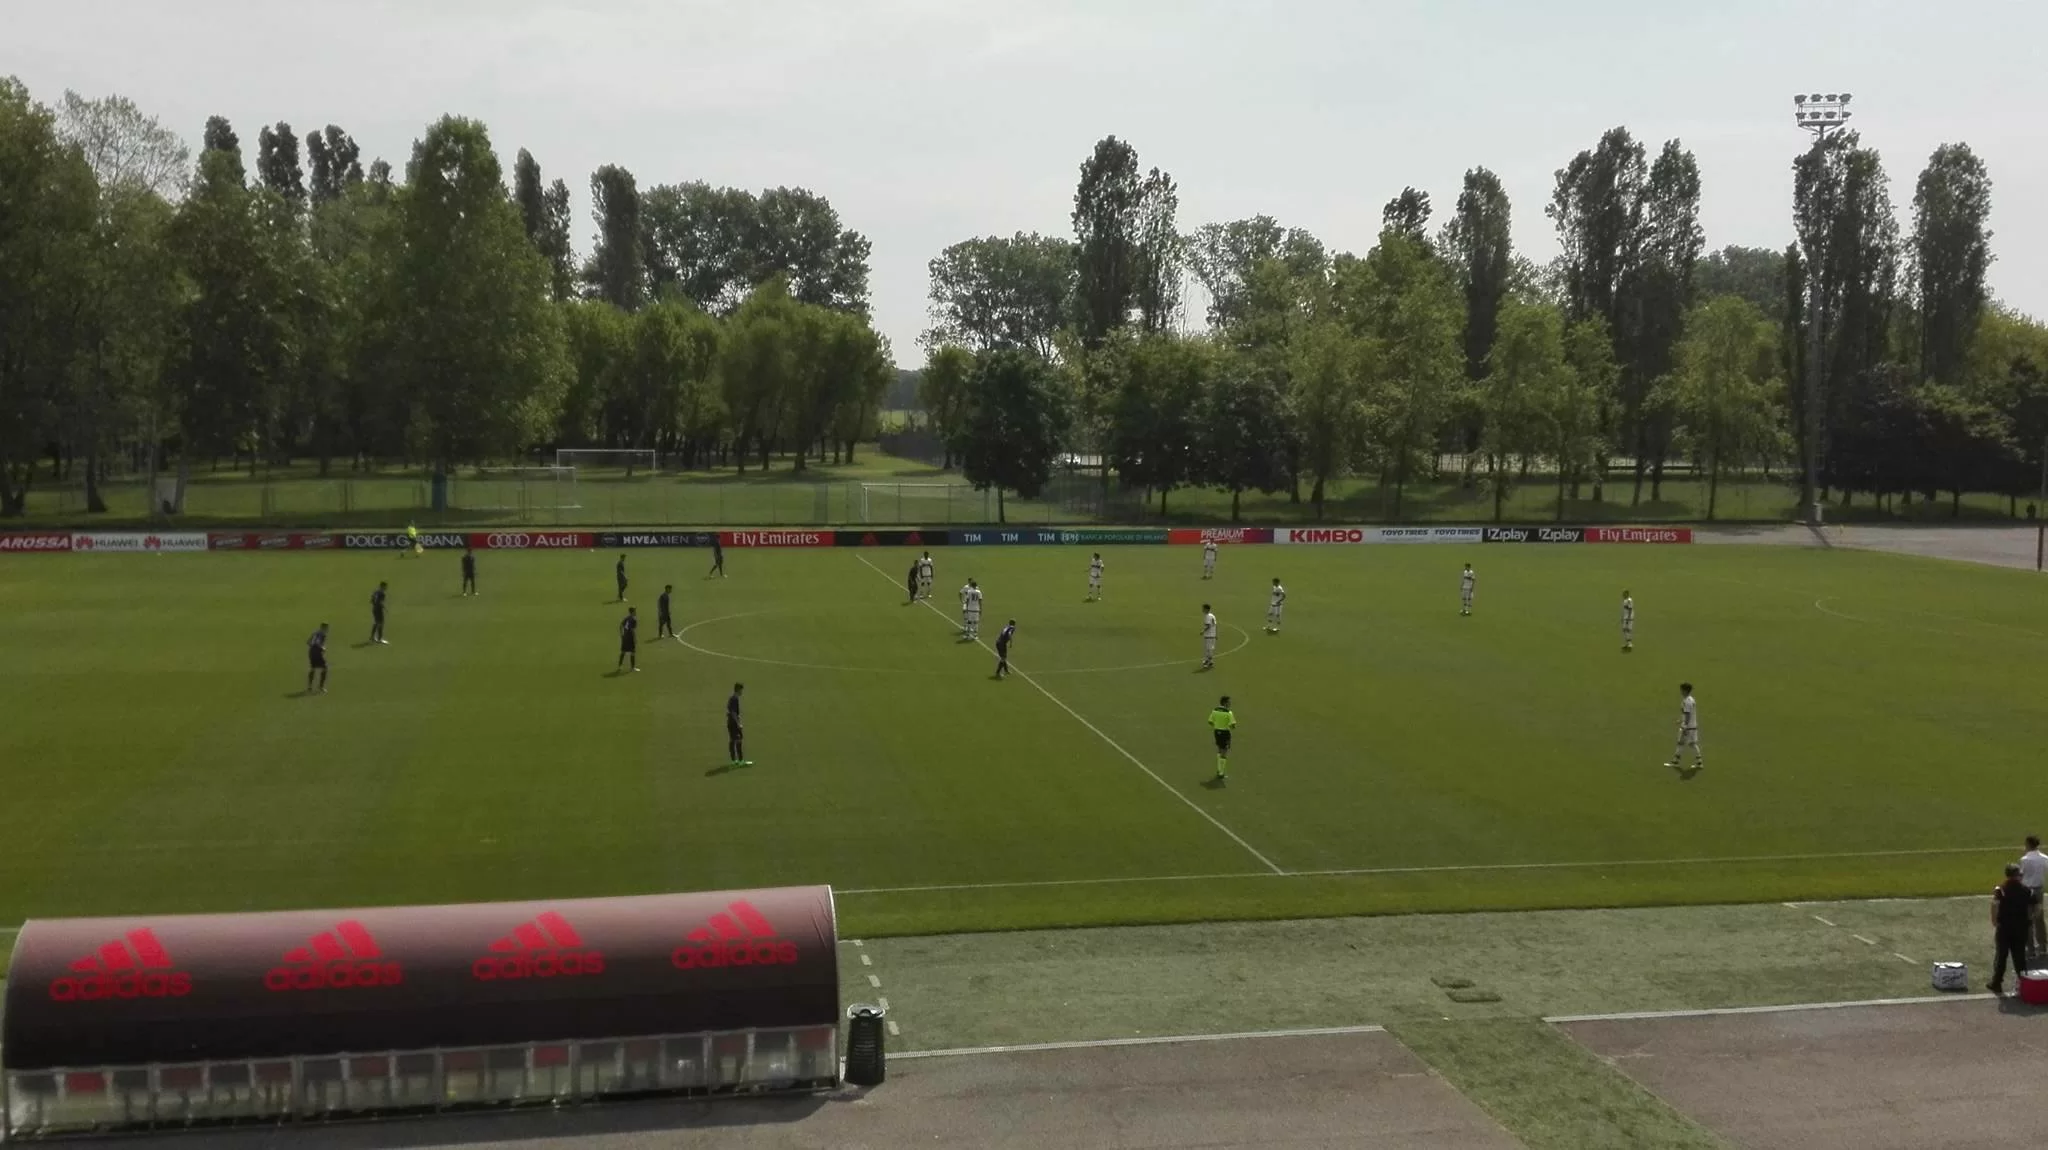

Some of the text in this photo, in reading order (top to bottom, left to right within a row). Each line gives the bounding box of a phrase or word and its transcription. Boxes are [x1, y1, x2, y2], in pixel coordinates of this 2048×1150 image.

[964, 533, 982, 542] TIM
[1001, 533, 1019, 542] TIM
[1038, 533, 1056, 542] TIM
[1200, 528, 1245, 538] PREMIUM
[1289, 529, 1363, 543] KIMBO
[1435, 528, 1481, 536] TOYO TIRES
[1599, 528, 1678, 542] Fly Emirates
[95, 539, 138, 547] HUAWEI
[162, 539, 205, 547] HUAWEI
[346, 535, 388, 546] DOLCE
[535, 534, 578, 546] Audi
[623, 535, 658, 545] NIVEA
[660, 535, 689, 545] MEN
[733, 531, 820, 547] Fly Emirates
[671, 937, 799, 970] adidas
[472, 947, 606, 981] adidas
[263, 960, 405, 991] adidas
[49, 969, 194, 1001] adidas
